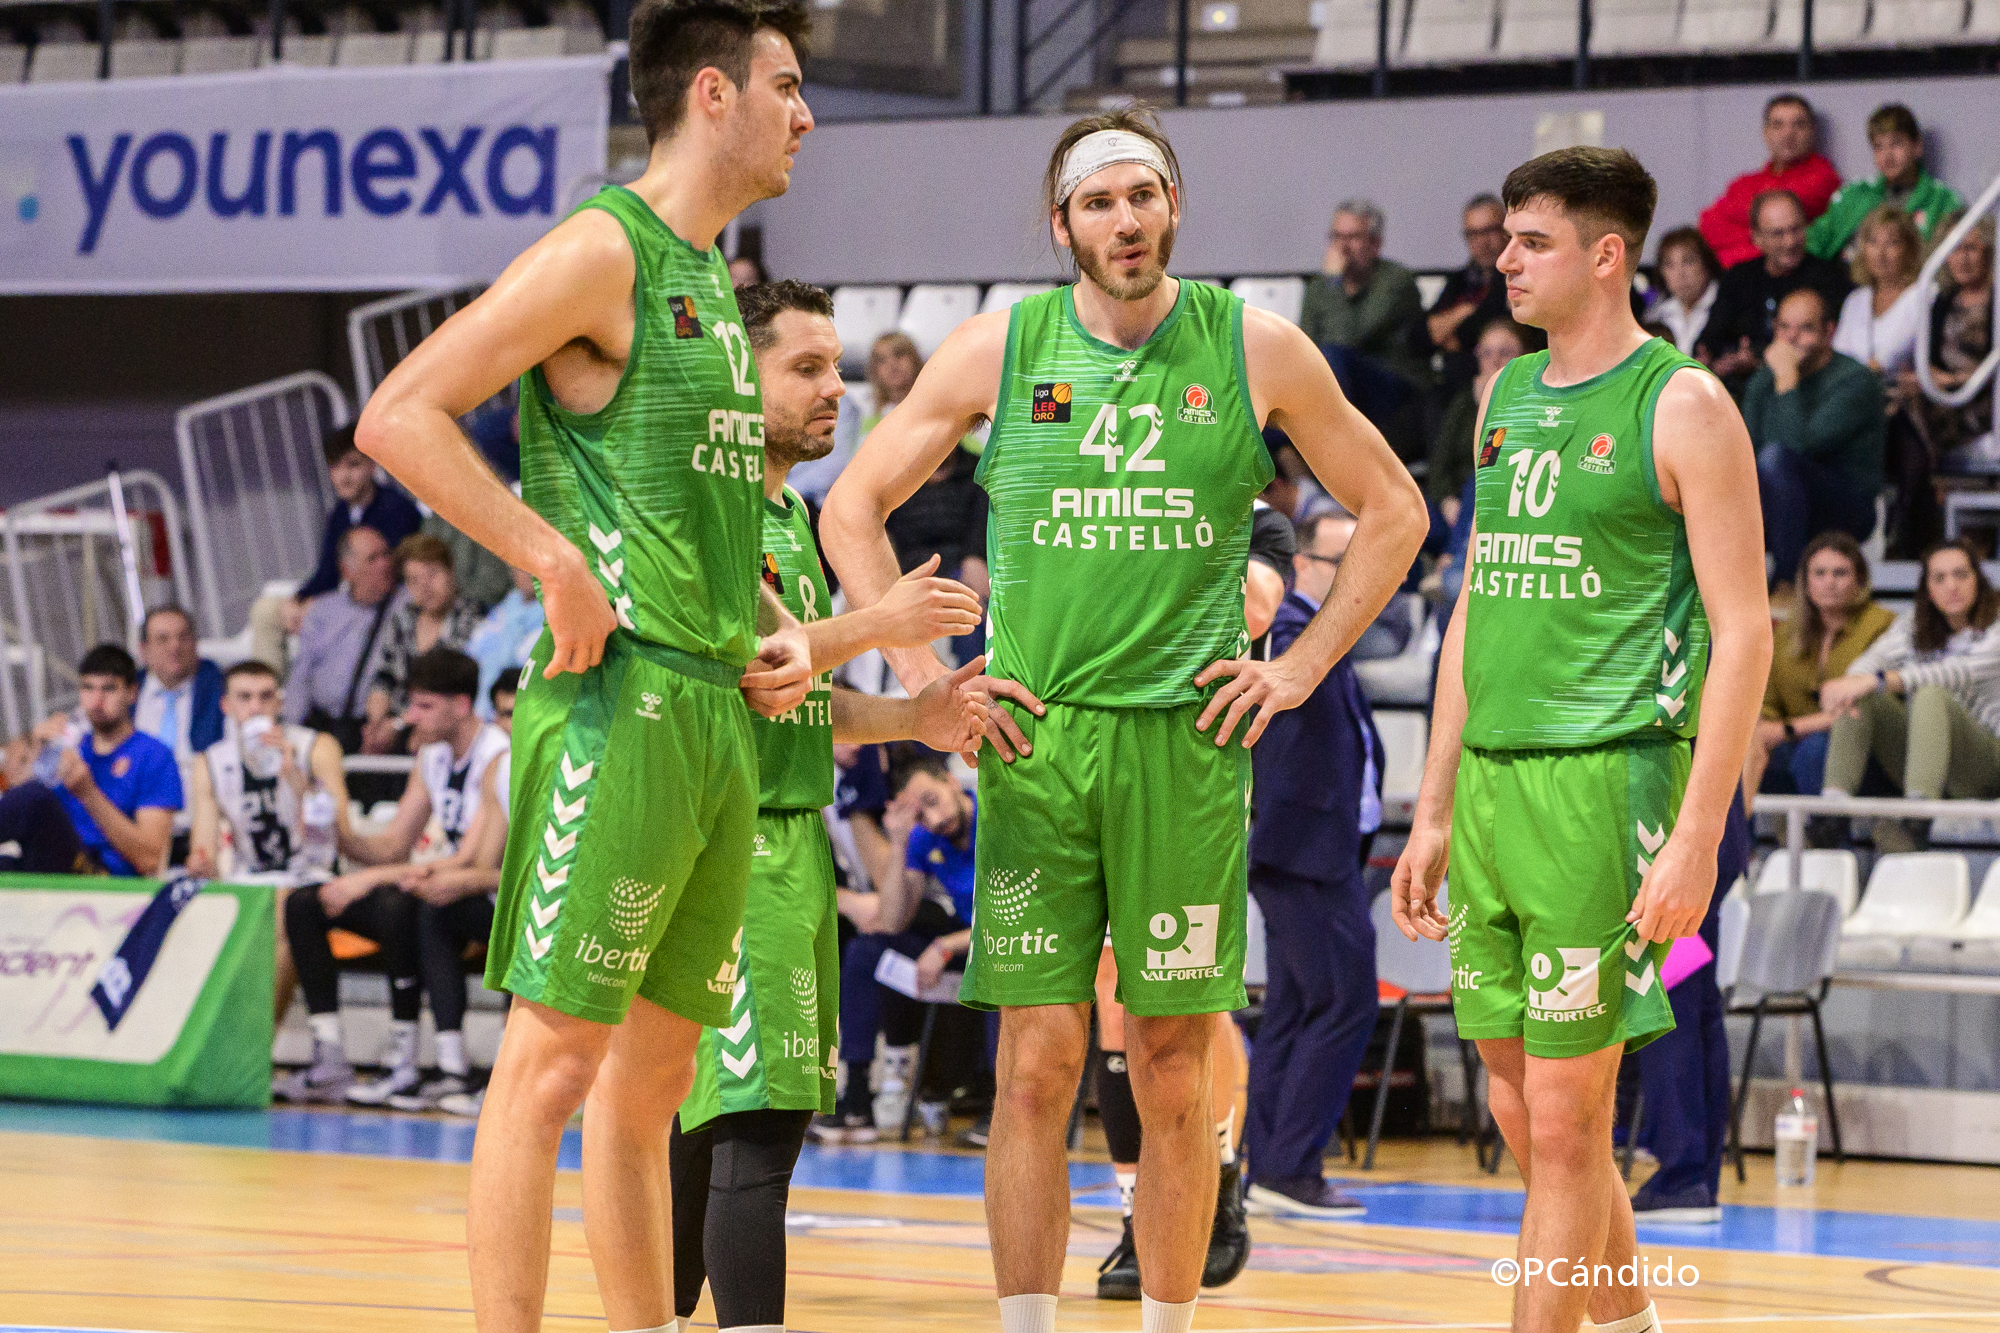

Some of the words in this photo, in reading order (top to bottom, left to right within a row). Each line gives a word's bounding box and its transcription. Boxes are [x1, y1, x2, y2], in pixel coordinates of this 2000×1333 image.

[66, 124, 560, 256] younexa
[712, 321, 756, 396] 12
[1034, 402, 1057, 412] LEB
[1035, 389, 1049, 399] Liga
[1033, 412, 1055, 421] ORO
[1183, 408, 1211, 417] AMICS
[1079, 403, 1166, 473] 42
[1507, 448, 1561, 518] 10
[1052, 487, 1195, 518] AMICS
[1032, 515, 1215, 551] CASTELLÓ
[1475, 532, 1583, 568] AMICS
[1140, 965, 1225, 982] VALFORTEC
